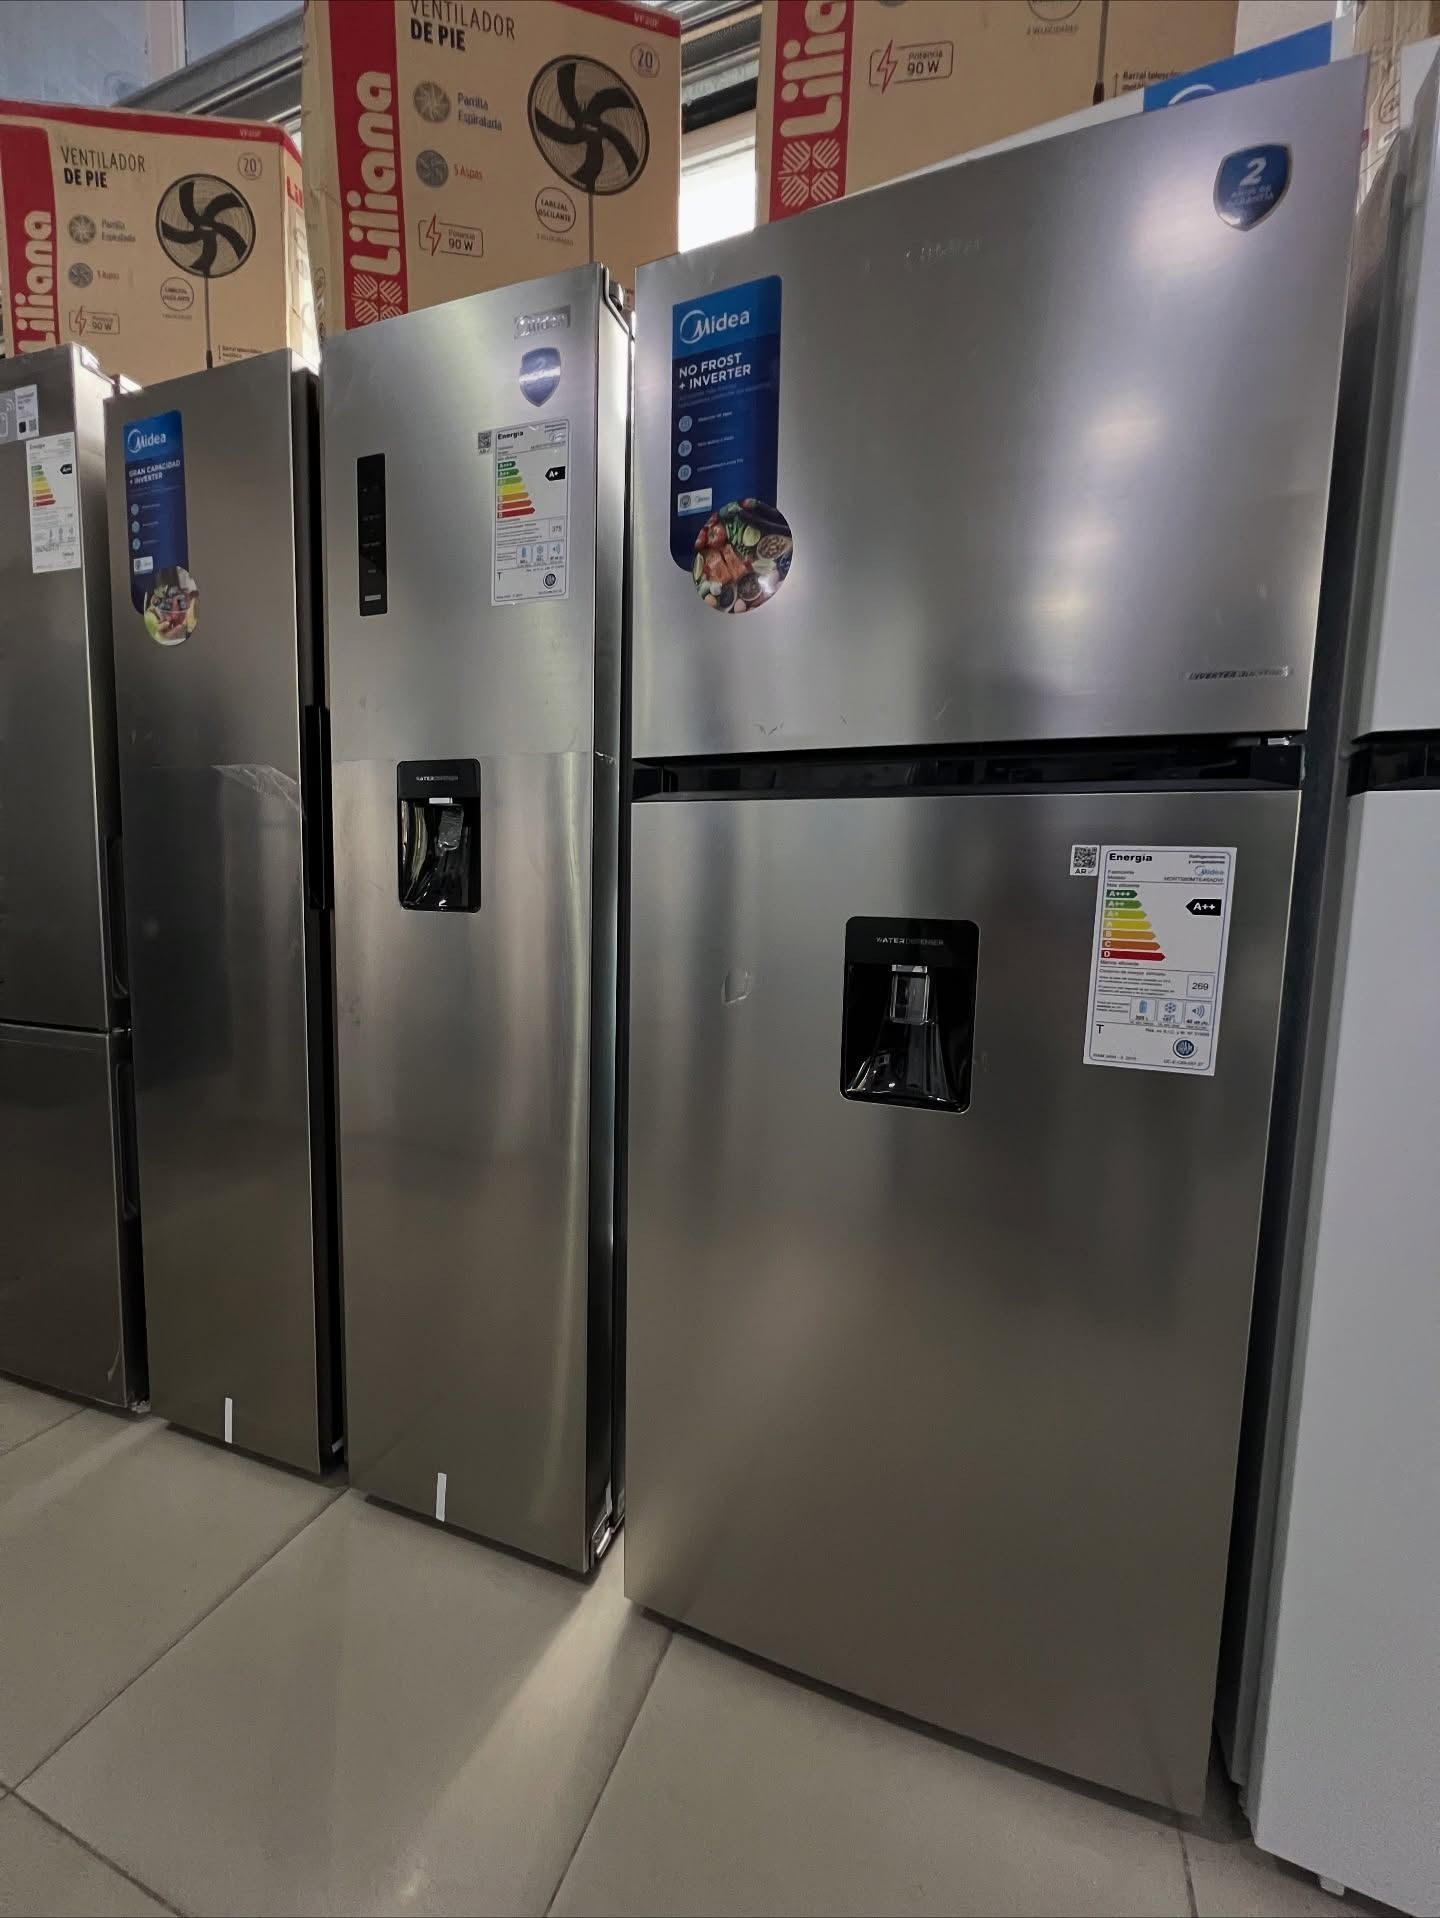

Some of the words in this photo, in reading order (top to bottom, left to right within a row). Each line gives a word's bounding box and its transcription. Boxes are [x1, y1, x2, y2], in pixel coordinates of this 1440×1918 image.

[409, 0, 515, 41] VENTILADOR
[410, 18, 434, 45] DE
[438, 24, 466, 52] PIE
[907, 62, 924, 76] 90
[927, 61, 940, 74] W
[60, 145, 146, 173] VENTILADOR
[242, 157, 258, 174] 20
[64, 167, 82, 186] DE
[85, 169, 108, 189] PIE
[346, 71, 401, 276] Liliana
[1239, 156, 1267, 186] 2
[447, 237, 462, 250] 90
[463, 239, 474, 251] W
[15, 210, 55, 356] Liliana
[680, 309, 751, 345] Midea
[679, 364, 699, 379] NO
[701, 352, 742, 374] FROST
[689, 363, 752, 390] INVERTER
[127, 428, 167, 454] Midea
[128, 466, 146, 479] GRAN
[146, 458, 181, 474] CAPACIDAD
[548, 470, 559, 479] A+
[134, 471, 163, 485] INVERTER
[497, 571, 502, 581] T
[1109, 852, 1153, 864] Energía
[1109, 889, 1131, 897] A+++
[1193, 901, 1216, 911] A++
[1105, 930, 1112, 938] B
[1103, 950, 1111, 958] D
[1191, 982, 1209, 991] 269
[1096, 1023, 1105, 1035] T
